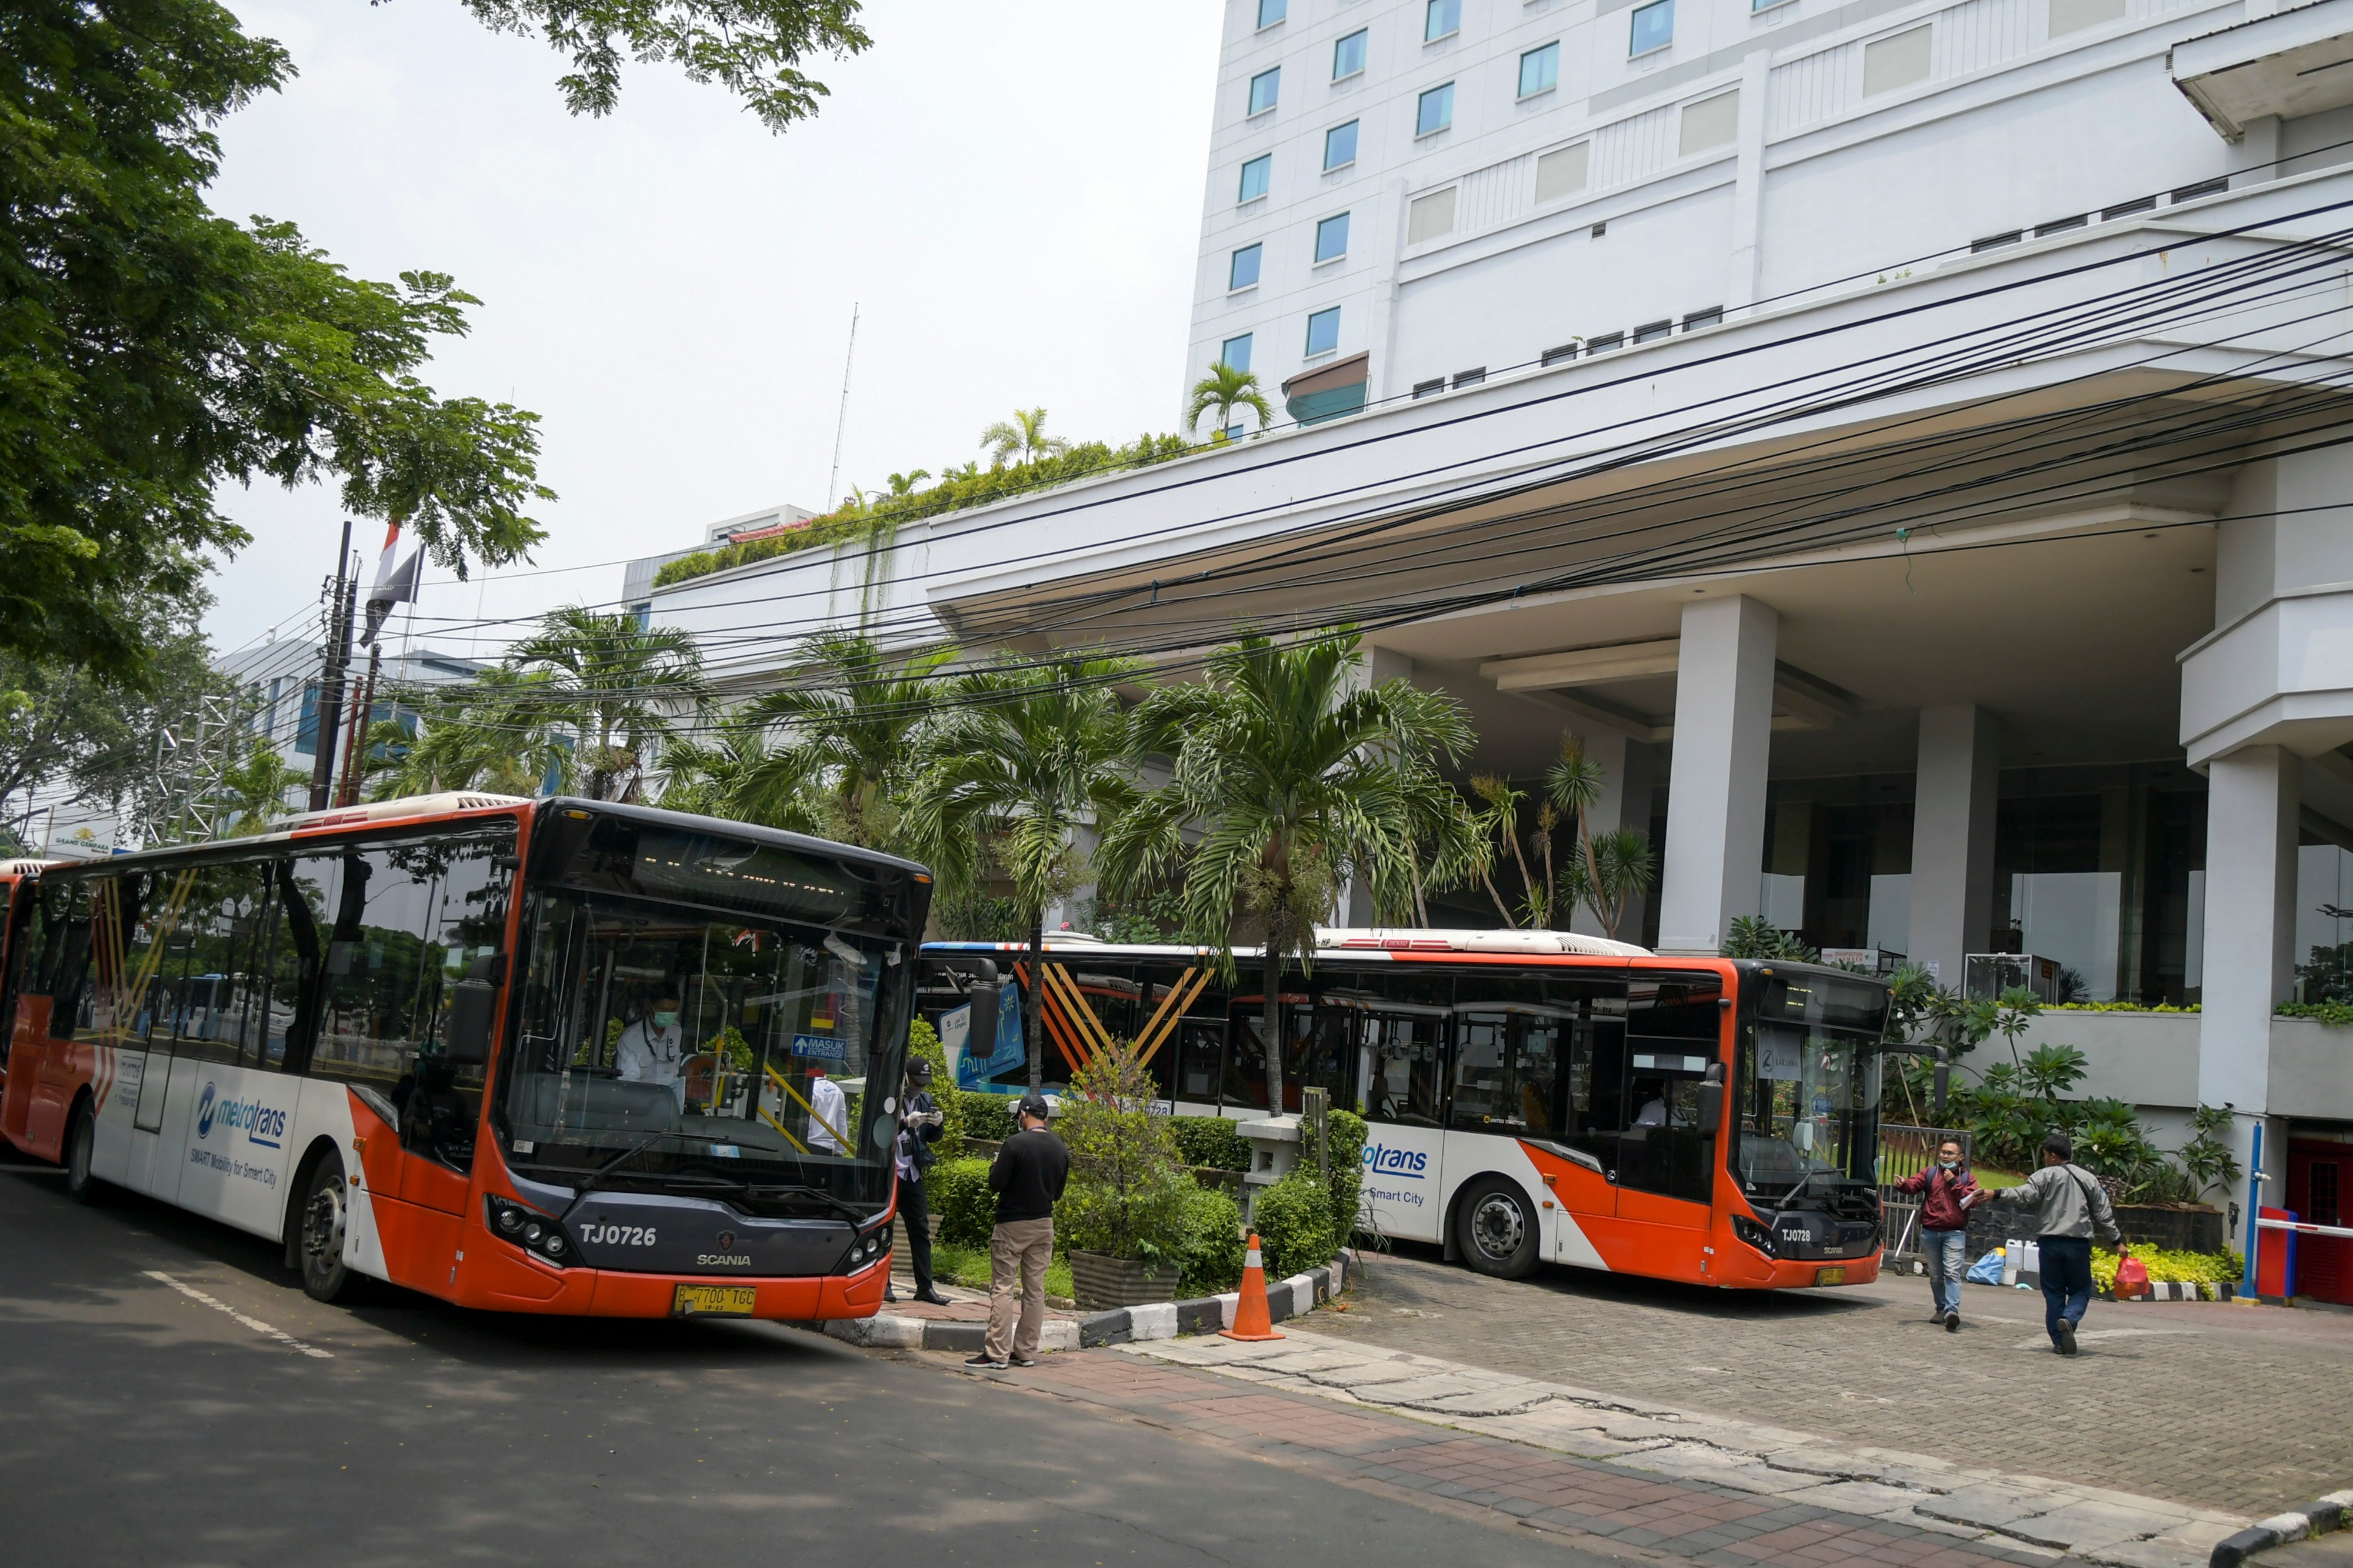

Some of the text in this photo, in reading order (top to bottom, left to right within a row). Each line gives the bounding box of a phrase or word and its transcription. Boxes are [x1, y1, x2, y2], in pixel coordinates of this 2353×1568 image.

[56, 838, 109, 850] GRAND CEMPAKA
[1321, 938, 1331, 946] HP
[808, 1039, 844, 1050] MASUK
[807, 1049, 843, 1058] ENTRANCE
[216, 1096, 286, 1149] metrotrans
[1360, 1143, 1427, 1179] otrans
[191, 1149, 278, 1189] SMART Mobility for Smart City
[1370, 1187, 1401, 1202] Smart
[1404, 1192, 1424, 1207] City
[579, 1223, 656, 1246] TJ0726
[1782, 1229, 1811, 1242] TJ0728
[696, 1255, 751, 1266] SCANIA
[678, 1288, 755, 1305] B 7700 TGC
